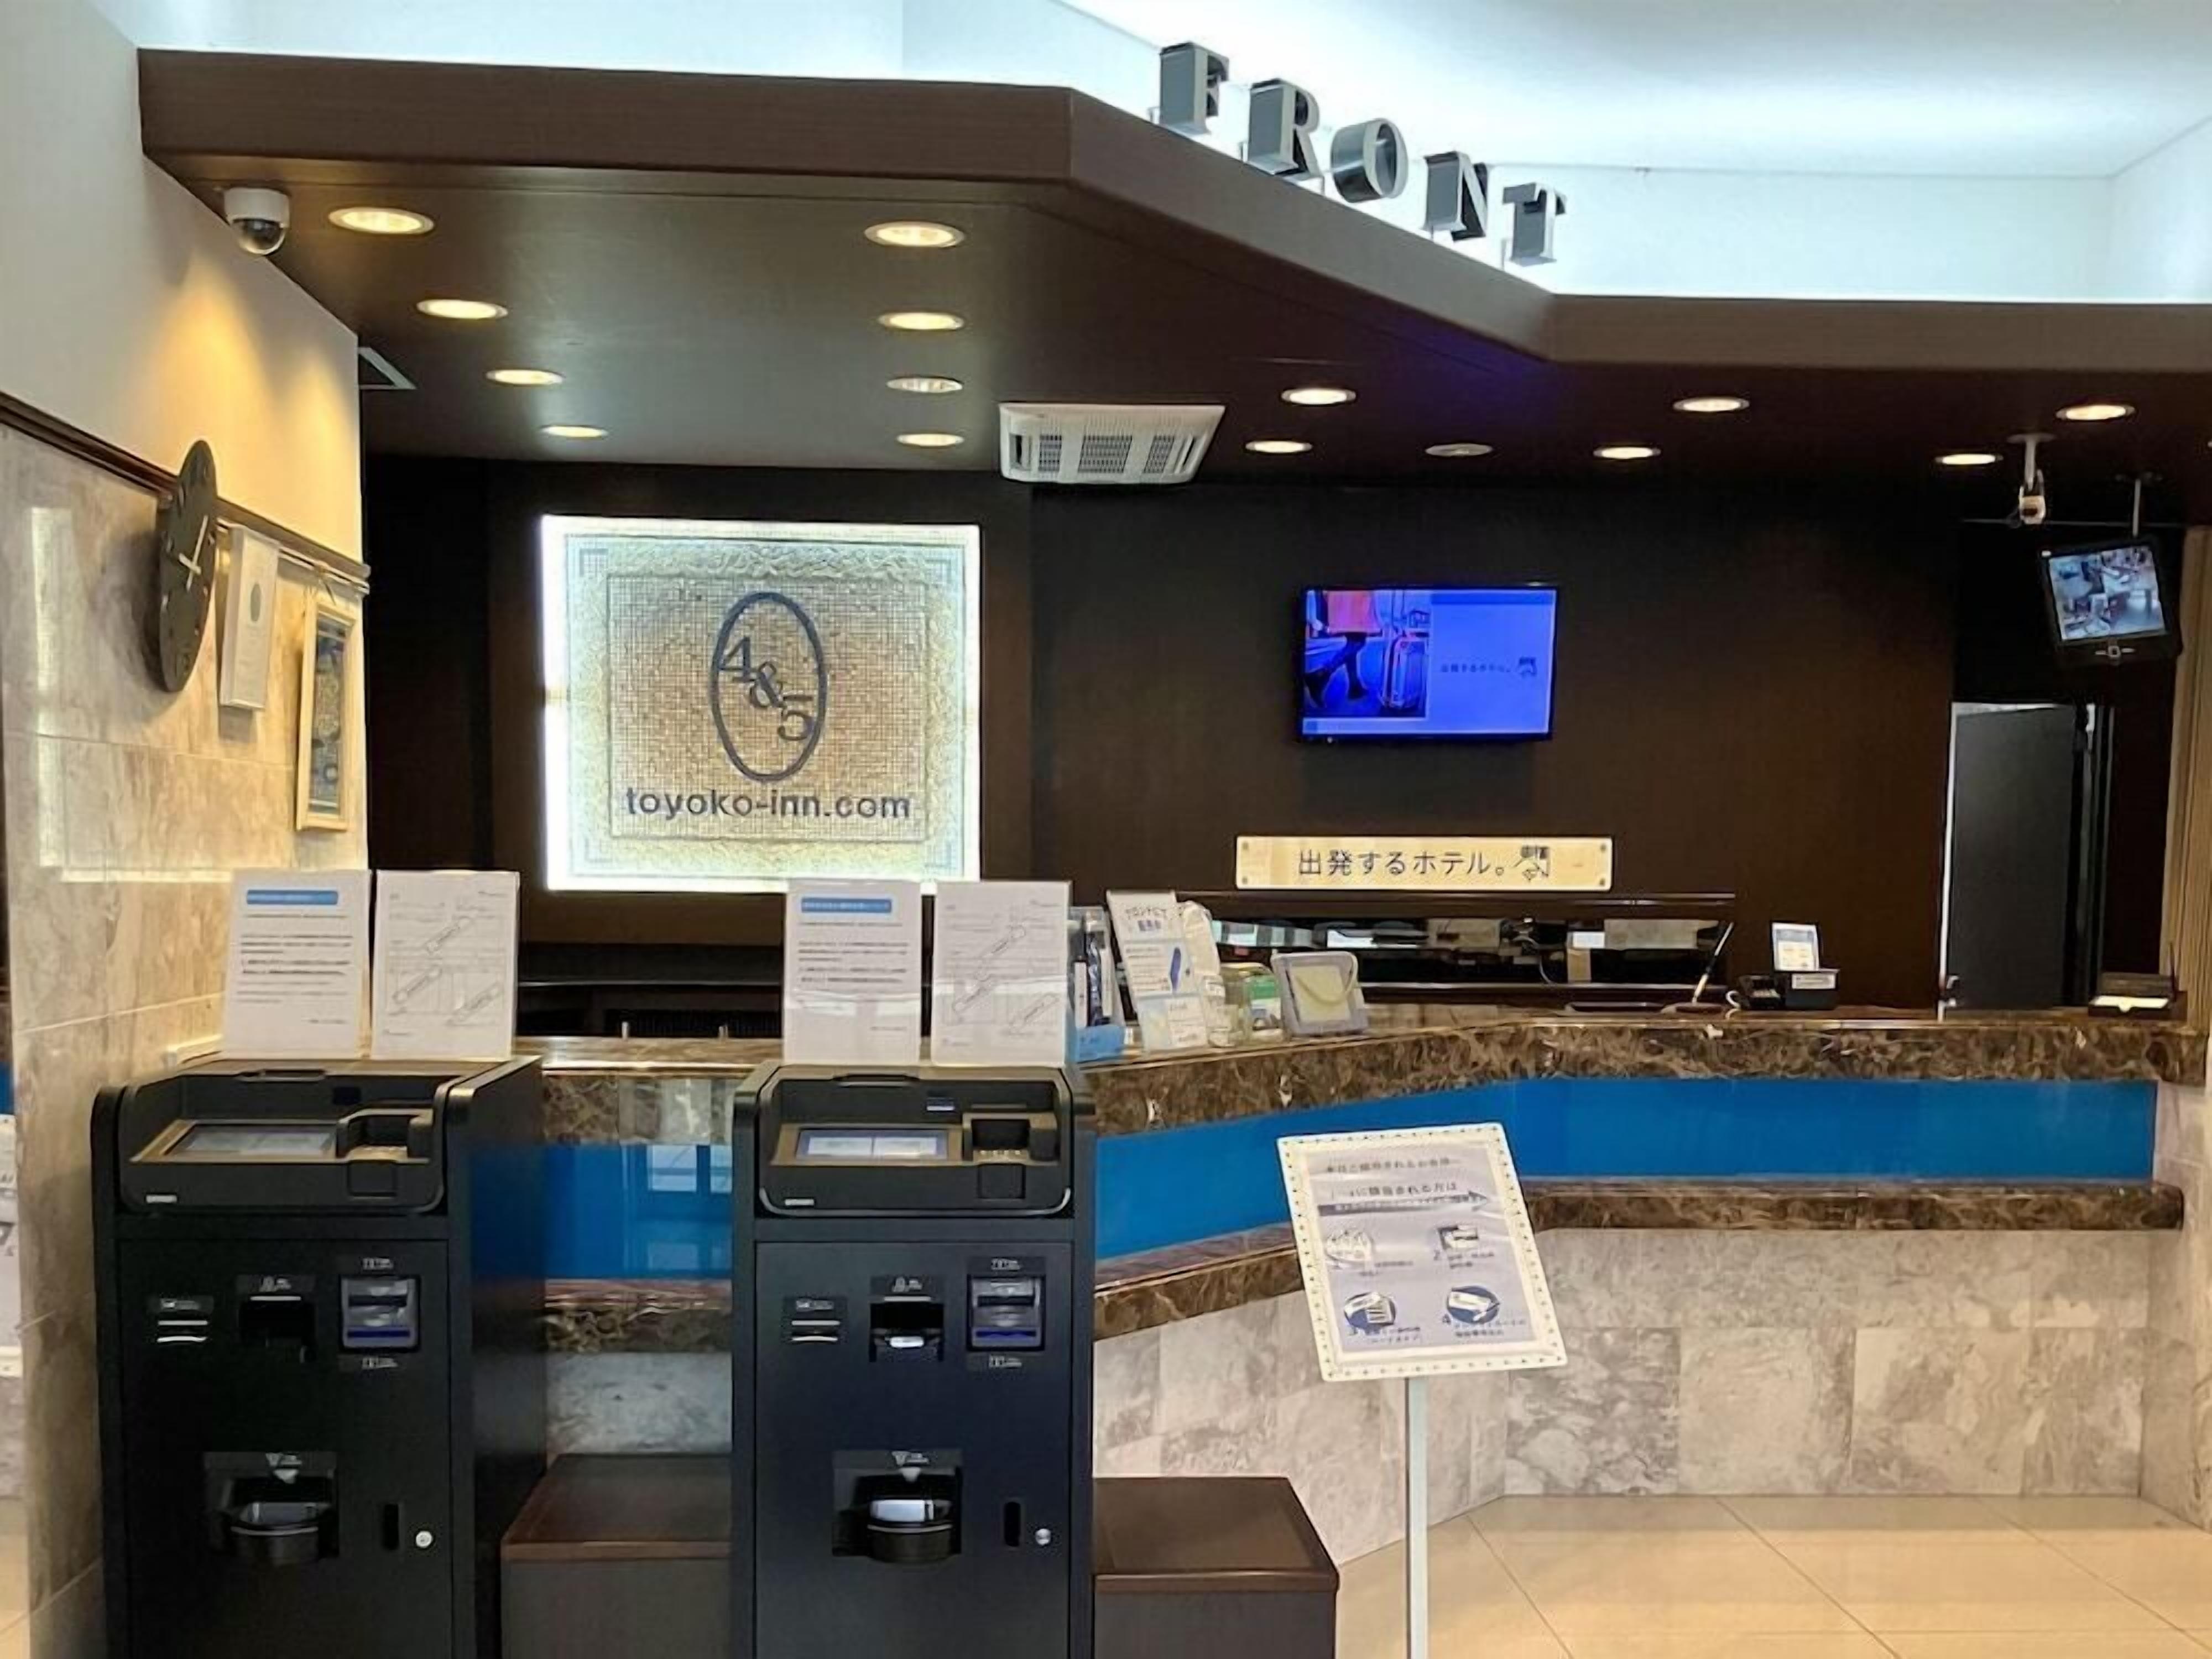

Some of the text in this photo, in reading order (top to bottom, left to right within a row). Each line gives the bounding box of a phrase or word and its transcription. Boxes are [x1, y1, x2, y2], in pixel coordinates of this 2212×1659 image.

[1159, 41, 1568, 267] FRONT
[625, 787, 911, 821] toyoko-inn.com
[1298, 848, 1505, 876] 出発するホテル。
